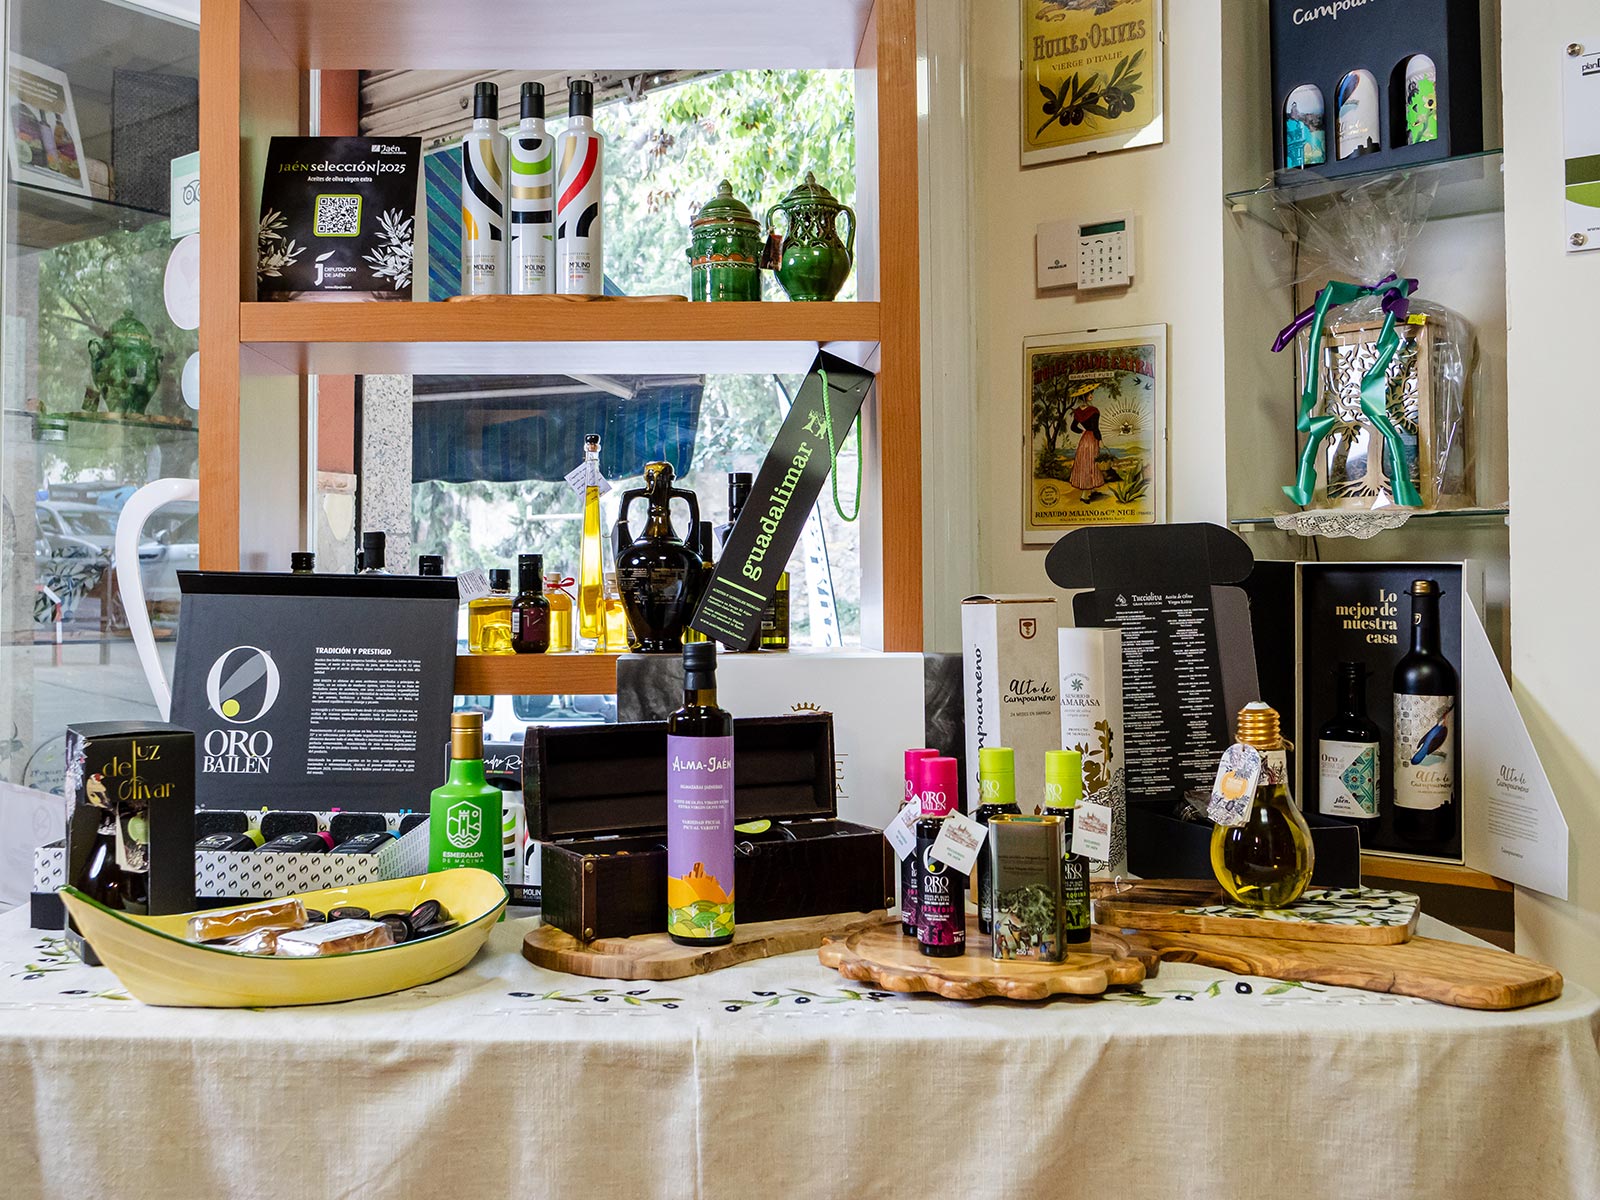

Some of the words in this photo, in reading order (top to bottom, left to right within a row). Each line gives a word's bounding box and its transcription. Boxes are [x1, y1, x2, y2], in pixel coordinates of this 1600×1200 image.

[1052, 59, 1083, 72] VIERGE
[1086, 51, 1123, 65] D'ITALIE
[1111, 354, 1155, 378] EXTRA
[742, 441, 814, 582] guadalimar
[1035, 510, 1068, 518] RINAUDO
[1379, 588, 1398, 603] Lo
[1335, 602, 1378, 620] mejor
[1379, 603, 1398, 617] de
[1343, 616, 1398, 630] nuestra
[1365, 633, 1398, 644] casa
[315, 646, 351, 655] TRADICIÓN
[358, 648, 392, 656] PRESTIGIO
[1009, 679, 1040, 696] Alto
[1040, 681, 1052, 694] de
[1003, 694, 1056, 705] Campoameno
[203, 729, 274, 758] ORO
[672, 755, 732, 773] ALMA-JAÉN
[1321, 753, 1338, 763] Oro
[1500, 764, 1519, 782] Alto
[921, 790, 947, 803] ORO
[924, 875, 949, 888] ORO
[522, 888, 542, 896] MOLIN
